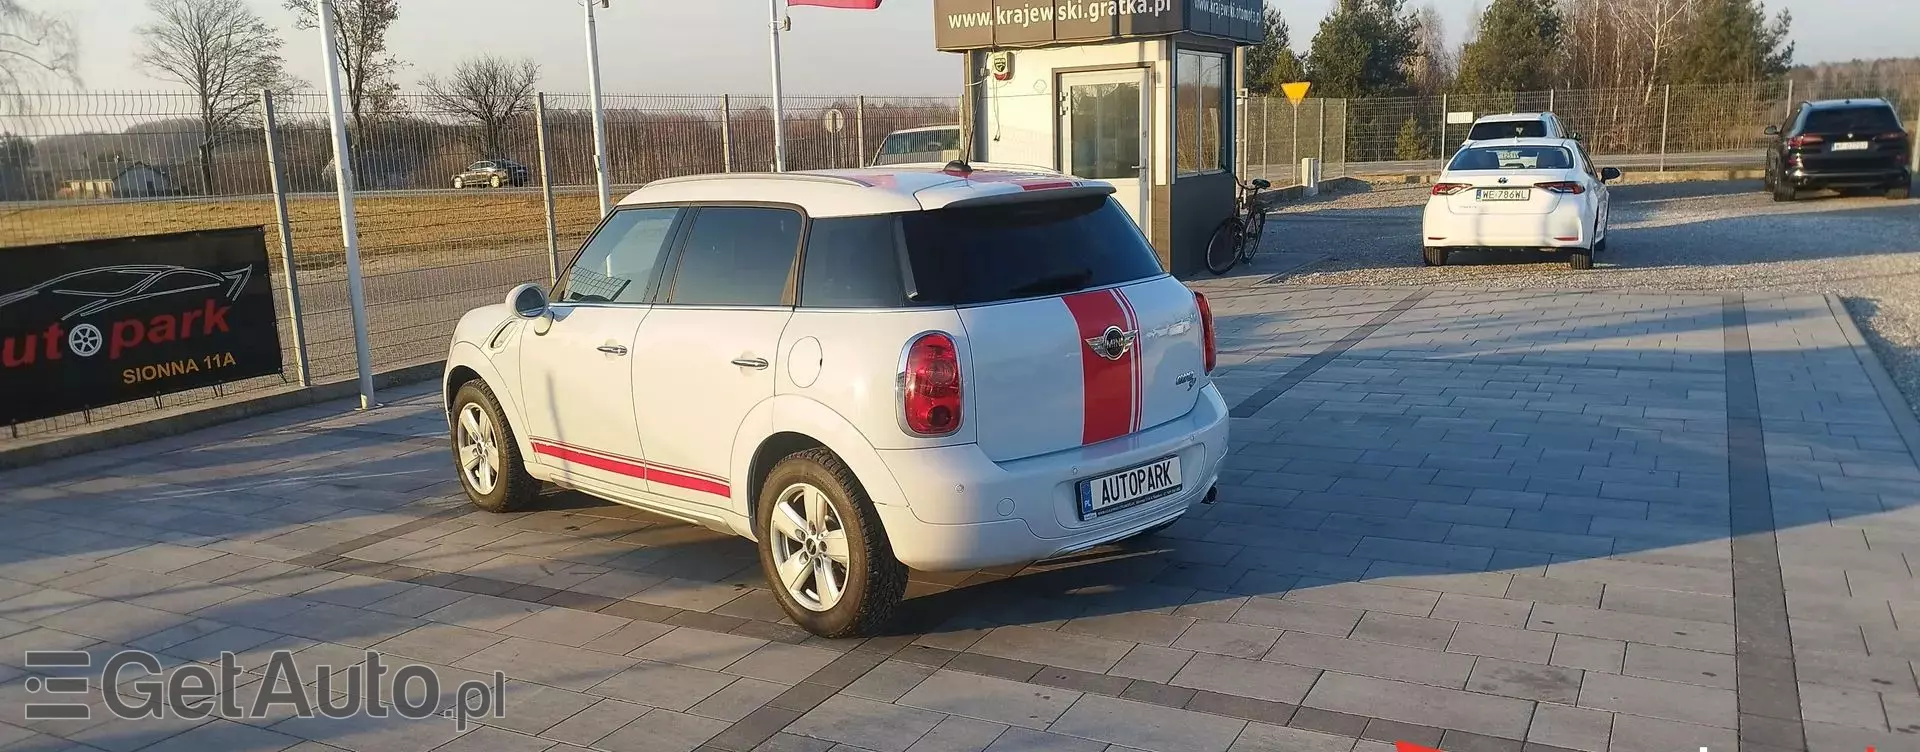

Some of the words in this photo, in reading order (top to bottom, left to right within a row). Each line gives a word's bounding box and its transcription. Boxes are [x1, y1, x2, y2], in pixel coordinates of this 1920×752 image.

[1482, 190, 1495, 199] WE
[1498, 190, 1527, 199] 786WL
[123, 358, 199, 385] SIONNA
[203, 351, 236, 371] 11A
[1101, 460, 1173, 505] AUTOPARK
